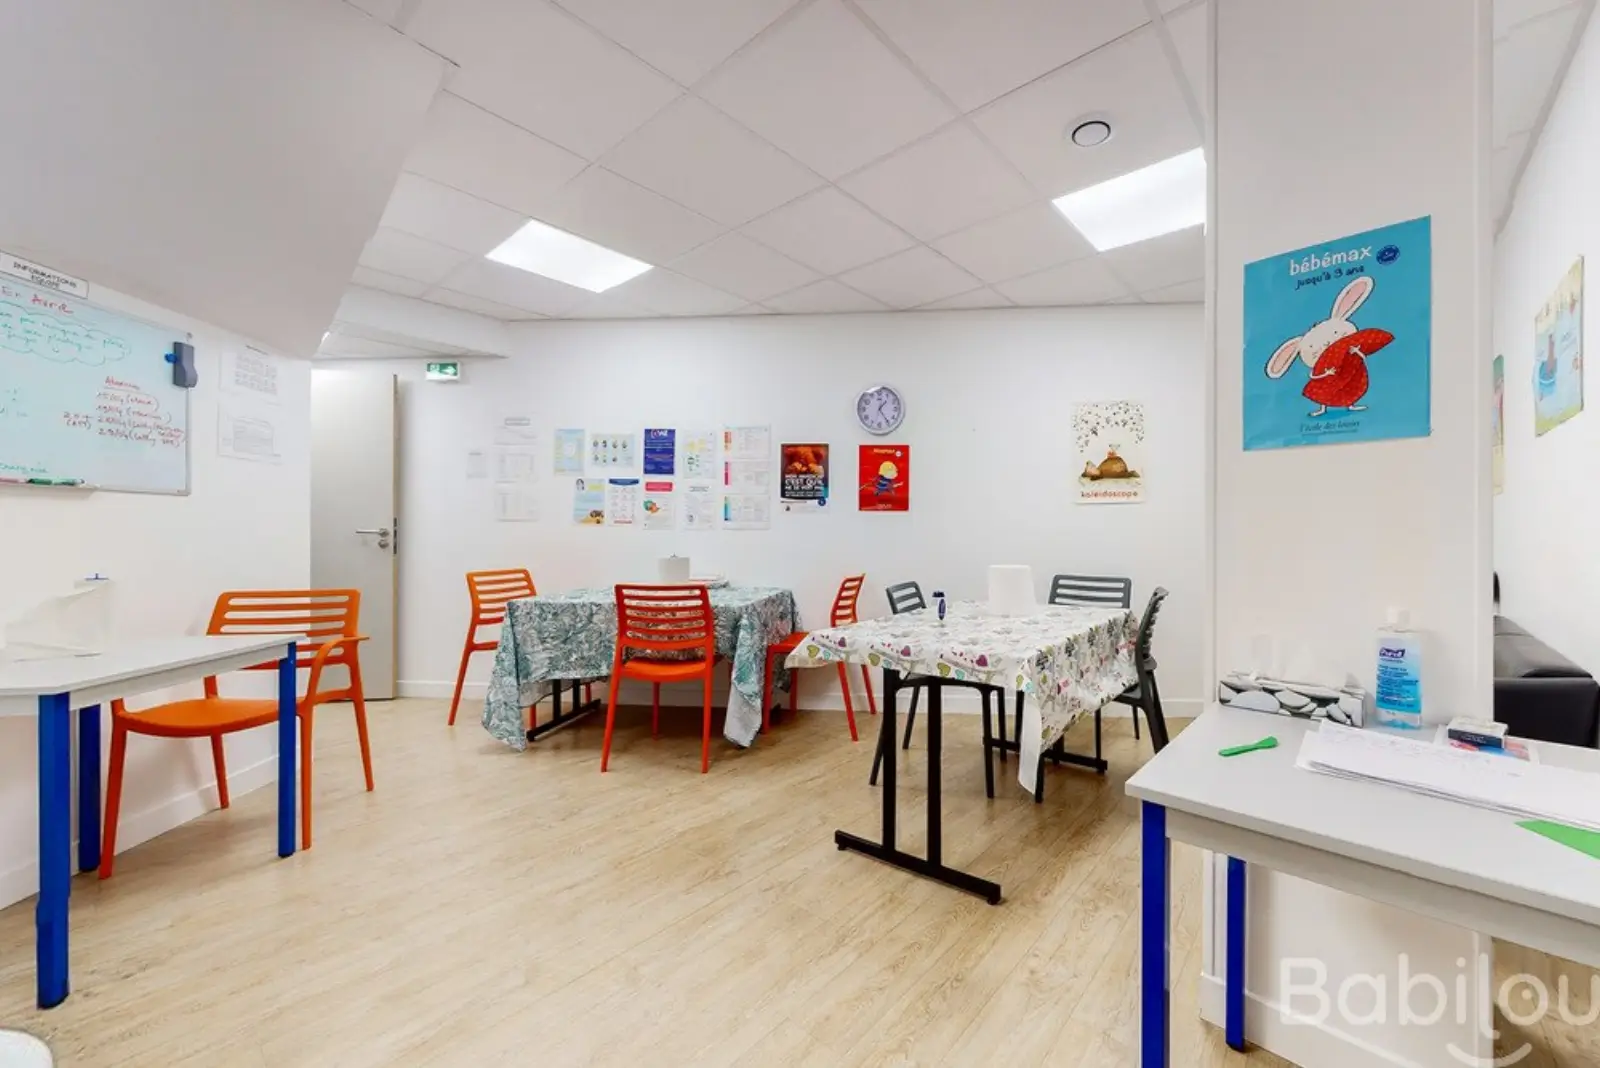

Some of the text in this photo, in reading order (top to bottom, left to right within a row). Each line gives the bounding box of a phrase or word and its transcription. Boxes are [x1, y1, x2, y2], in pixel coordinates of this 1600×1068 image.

[1289, 246, 1372, 276] bébémax
[1295, 265, 1365, 291] jusqu'à 3 ans
